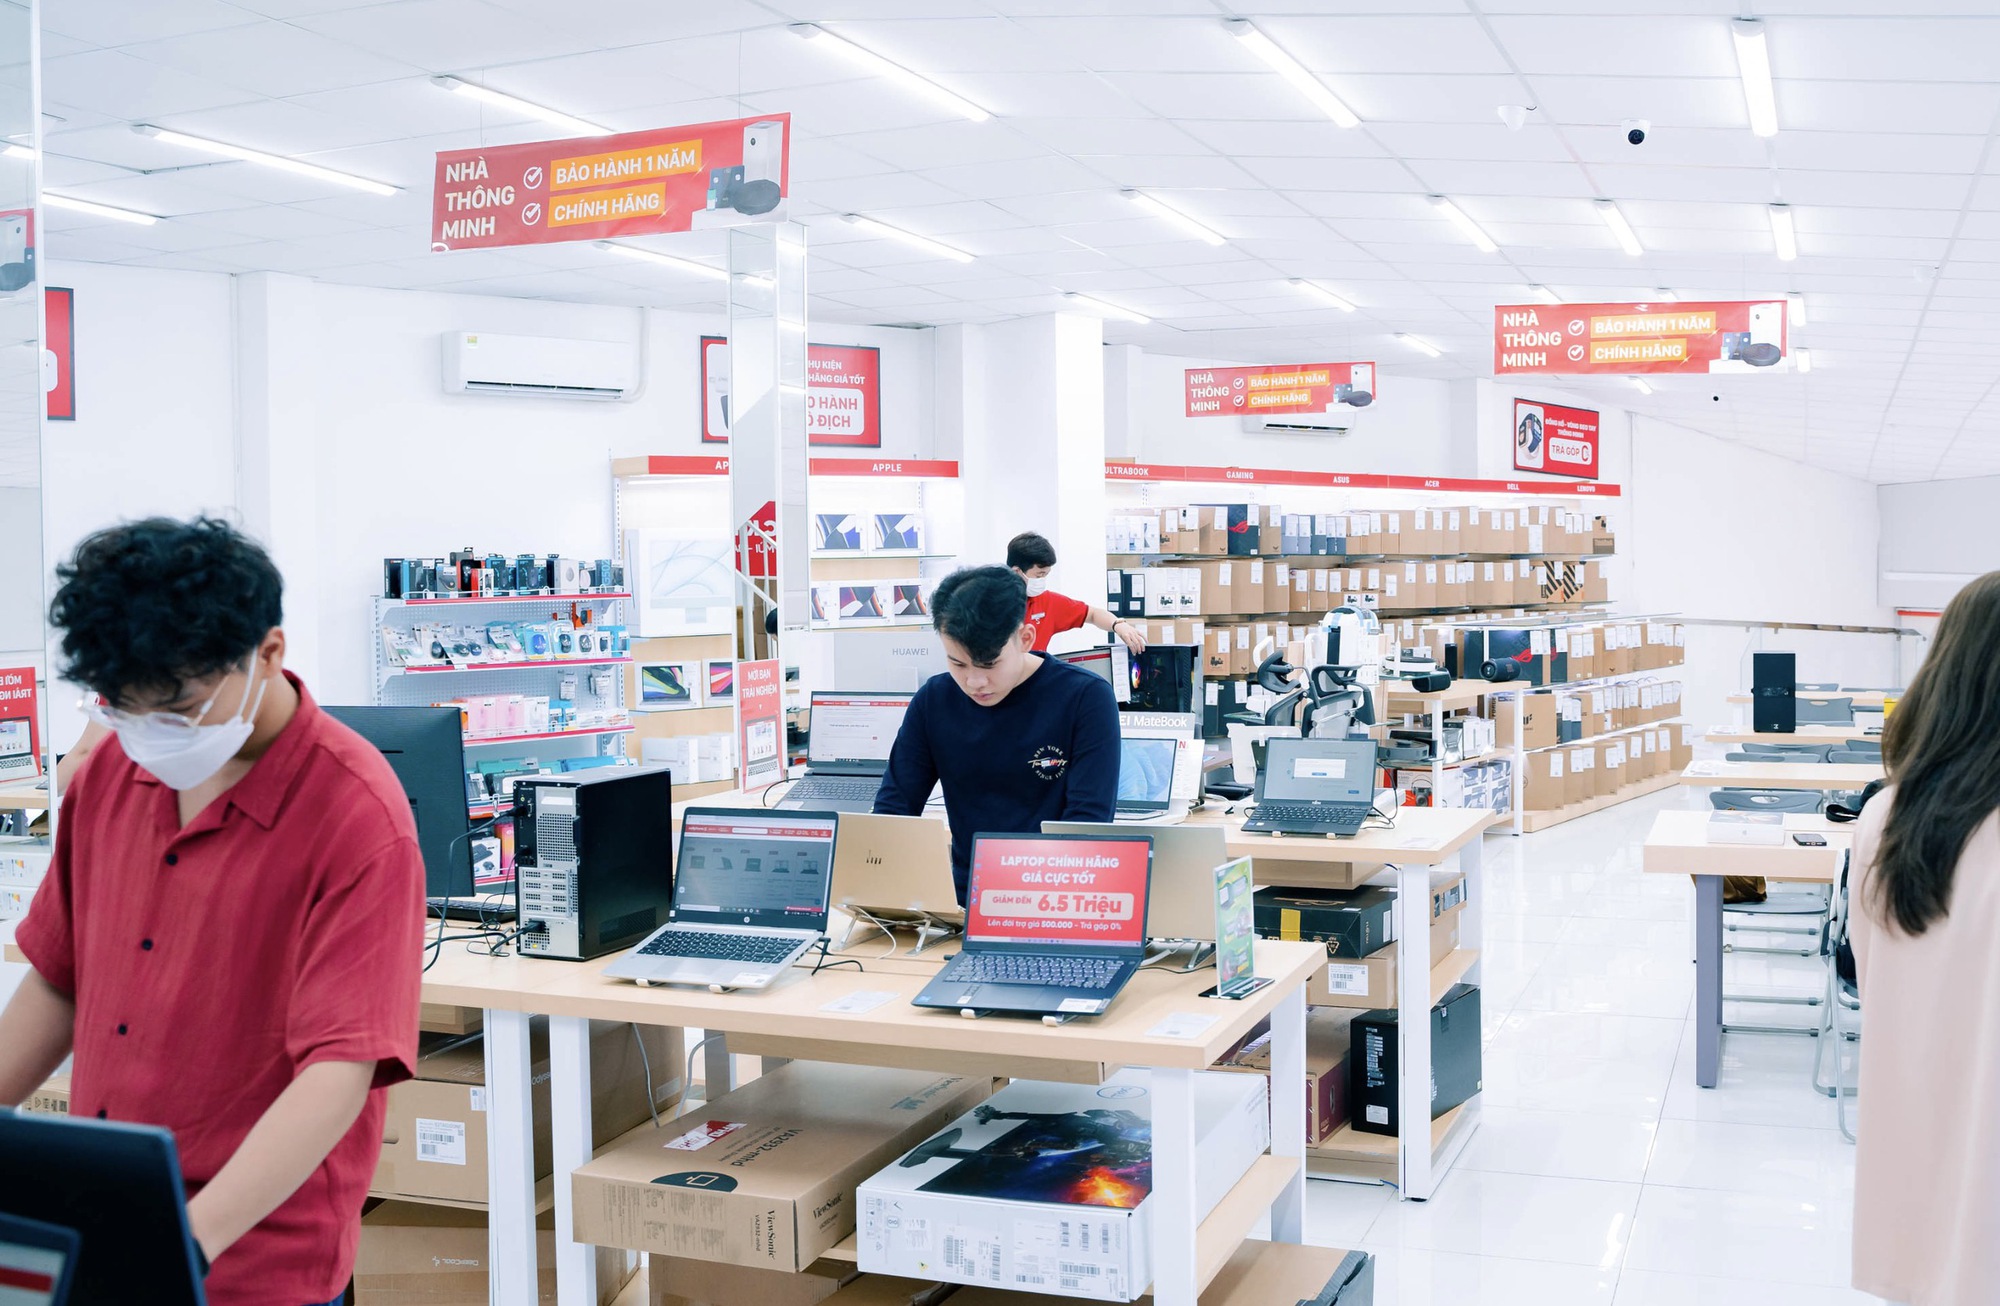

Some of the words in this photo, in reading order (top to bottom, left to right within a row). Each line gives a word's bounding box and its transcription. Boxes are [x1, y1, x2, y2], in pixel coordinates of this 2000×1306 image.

[446, 156, 489, 183] NHÀ
[556, 162, 590, 184] BẢO
[594, 157, 642, 179] HÀNH
[646, 156, 653, 171] 1
[657, 148, 696, 171] NĂM
[445, 185, 516, 212] THÔNG
[554, 197, 608, 221] CHÍNH
[611, 193, 660, 215] HÃNG
[442, 216, 496, 240] MINH
[1502, 309, 1540, 327] NHÀ
[1595, 319, 1623, 334] BẢO
[1626, 318, 1667, 332] HÀNH
[1670, 320, 1676, 330] 1
[1678, 316, 1711, 330] NĂM
[1503, 330, 1562, 348] THÔNG
[1595, 345, 1640, 359] CHÍNH
[1642, 344, 1683, 358] HÃNG
[808, 360, 820, 371] HỤ
[822, 360, 842, 371] KIỆN
[1502, 352, 1547, 367] MINH
[834, 372, 849, 384] GIÁ
[849, 373, 865, 385] TỐT
[1190, 372, 1214, 385] NHÀ
[1271, 374, 1298, 386] HÀNH
[1305, 373, 1326, 384] NĂM
[1191, 386, 1229, 399] THÔNG
[1251, 394, 1281, 406] CHÍNH
[1282, 392, 1308, 403] HÃNG
[819, 394, 858, 410] HÀNH
[1190, 400, 1220, 412] MINH
[817, 414, 851, 430] ĐỊCH
[872, 463, 902, 472] APPLE
[1105, 466, 1149, 476] ULTRABOOK
[1226, 471, 1254, 479] GAMING
[1333, 476, 1350, 484] ASUS
[1425, 480, 1440, 488] ACER
[1506, 483, 1519, 491] DELL
[602, 560, 611, 586] G502
[892, 648, 929, 656] HUAWEI
[1133, 715, 1188, 727] MateBook
[1047, 745, 1063, 756] YORK
[1001, 855, 1045, 867] LAPTOP
[1047, 854, 1083, 867] CHÍNH
[1085, 854, 1120, 868] HÃNG
[1021, 870, 1042, 883] GIÁ
[1044, 872, 1069, 886] CỰC
[1072, 869, 1096, 884] TỐT
[1015, 895, 1032, 905] ĐẾN
[1037, 894, 1068, 912] 6.5
[1072, 894, 1122, 918] Triệu
[987, 919, 1001, 927] Lên
[1002, 919, 1014, 928] đời
[1015, 919, 1026, 929] trợ
[1041, 918, 1073, 929] 500.000
[812, 1194, 842, 1219] ViewSonic
[766, 1209, 776, 1260] ViewSonic
